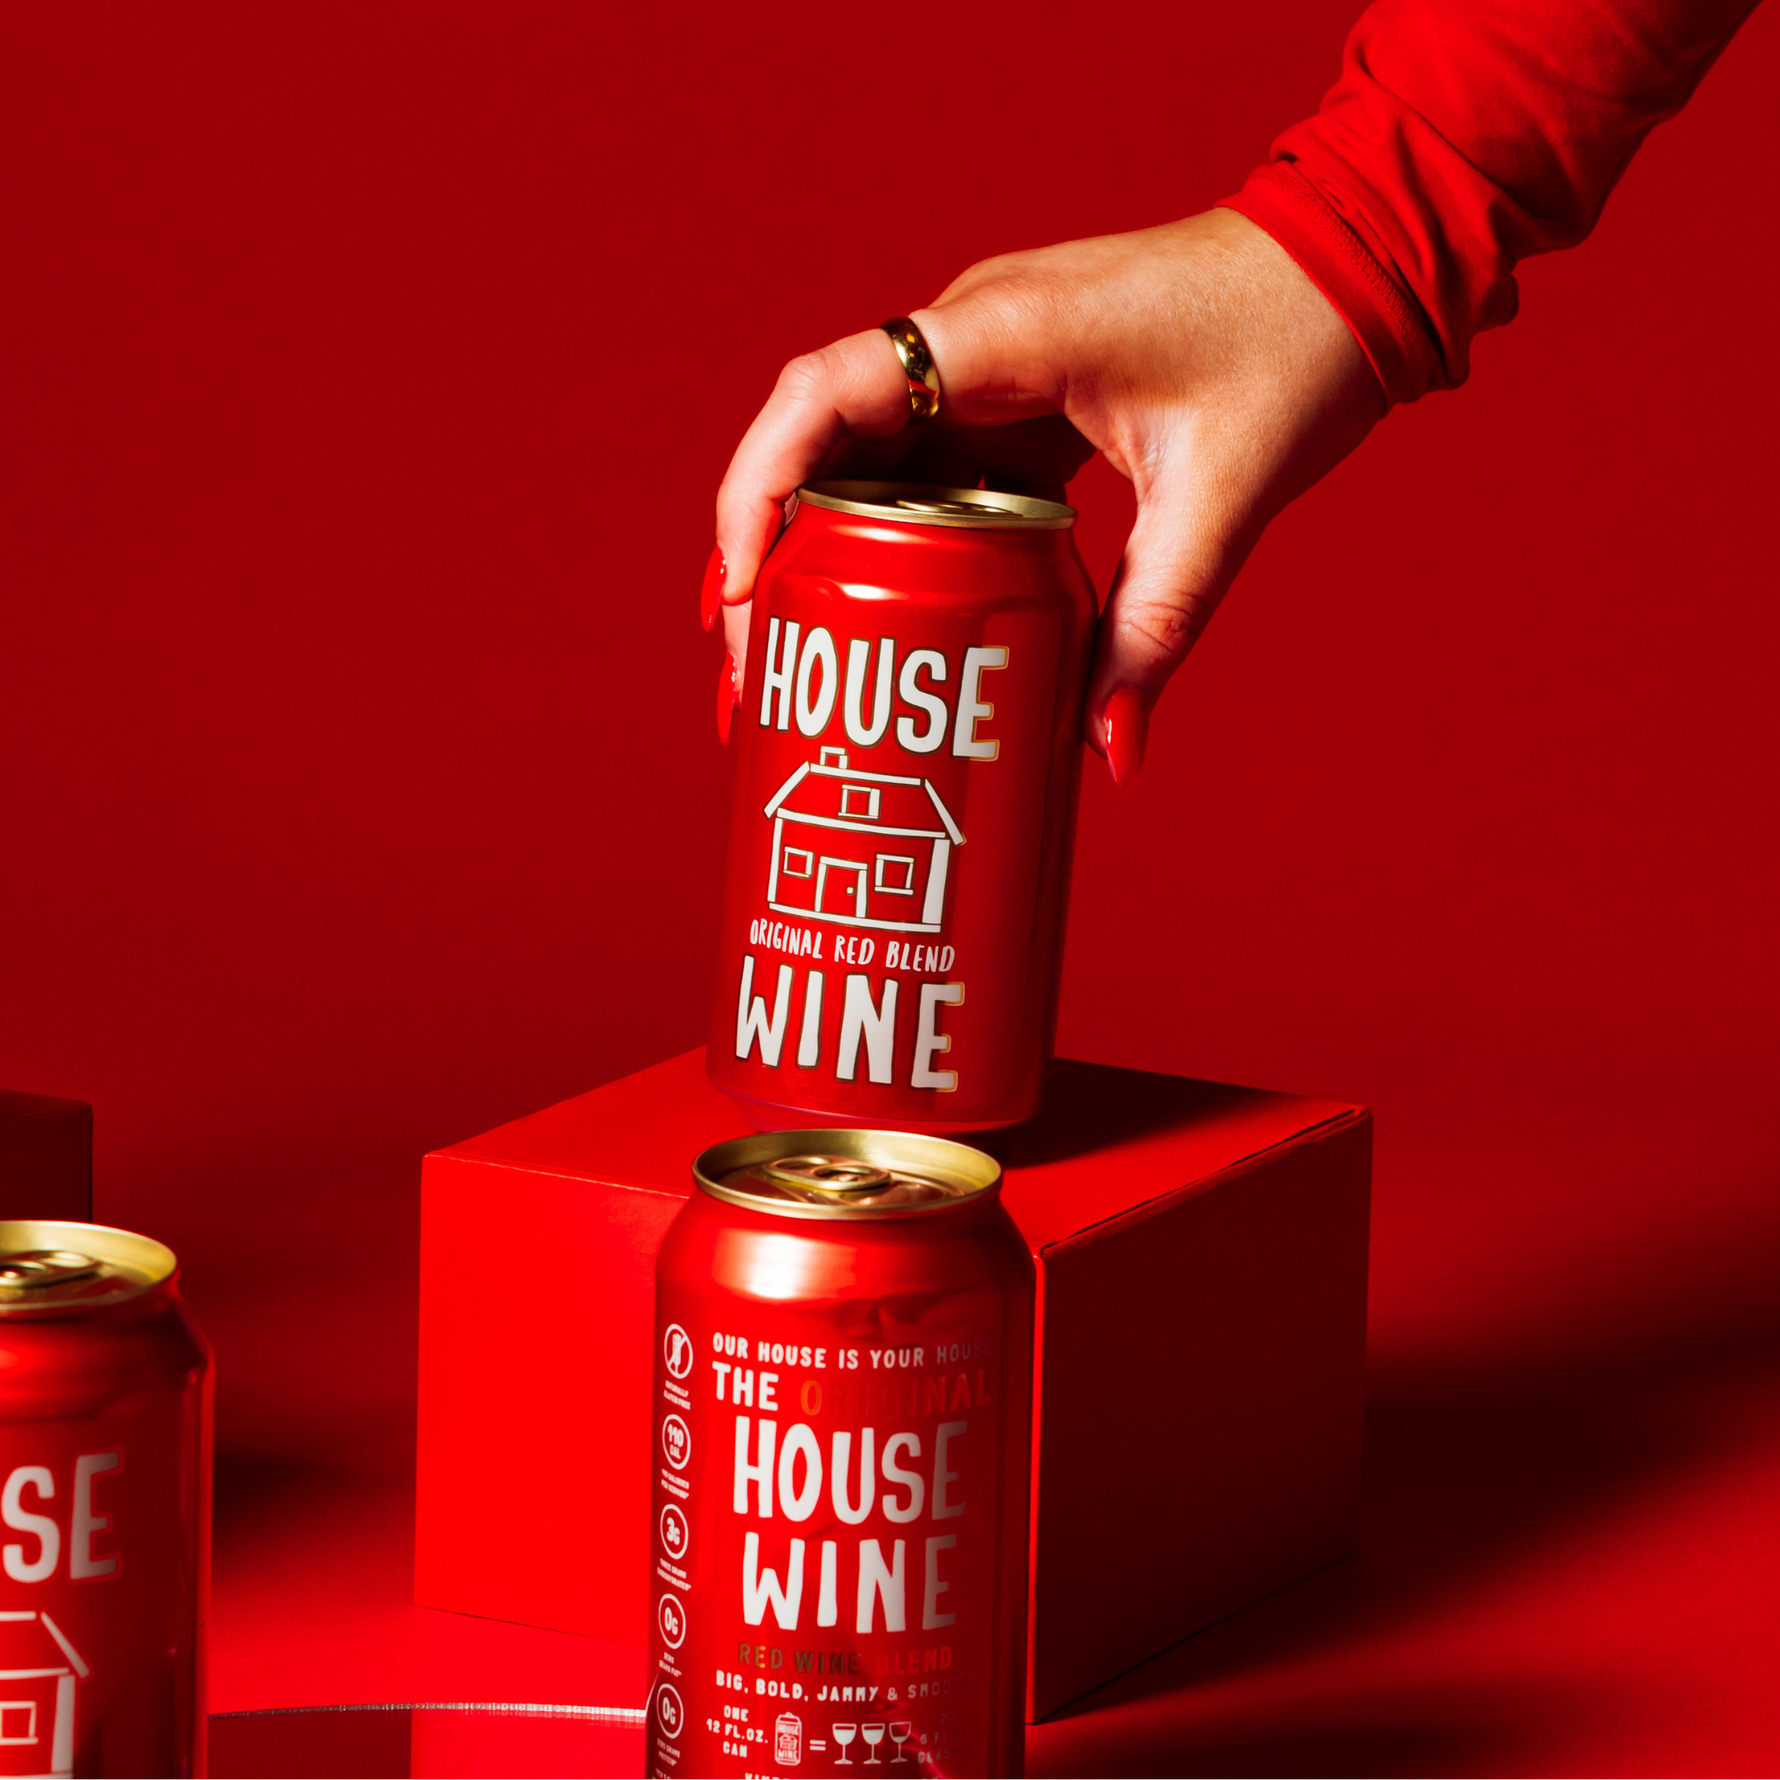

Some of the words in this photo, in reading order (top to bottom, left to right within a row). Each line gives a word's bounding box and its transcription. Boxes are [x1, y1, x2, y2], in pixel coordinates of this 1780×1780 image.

[759, 616, 1009, 761] HOUSE
[750, 918, 823, 960] ORIGINAL
[834, 934, 876, 966] RED
[885, 940, 956, 973] BLEND
[735, 954, 965, 1092] WINE
[712, 1331, 749, 1360] OUR
[758, 1340, 827, 1369] HOUSE
[838, 1348, 859, 1370] IS
[869, 1347, 925, 1370] YOUR
[712, 1360, 780, 1413] THE
[800, 1368, 992, 1419] ORIGINAL
[667, 1423, 685, 1448] 110
[733, 1414, 968, 1525] HOUSE
[0, 1451, 120, 1584] SE
[742, 1530, 957, 1634] WINE
[738, 1642, 783, 1669] RED
[795, 1650, 862, 1676] WINE
[873, 1645, 952, 1677] BLEND
[716, 1669, 749, 1695] BIG,
[755, 1677, 809, 1702] BOLD,
[816, 1684, 879, 1702] JAMMY
[886, 1686, 898, 1702] &
[706, 1718, 721, 1734] 12
[723, 1704, 749, 1723] ONE
[722, 1740, 748, 1759] CAN
